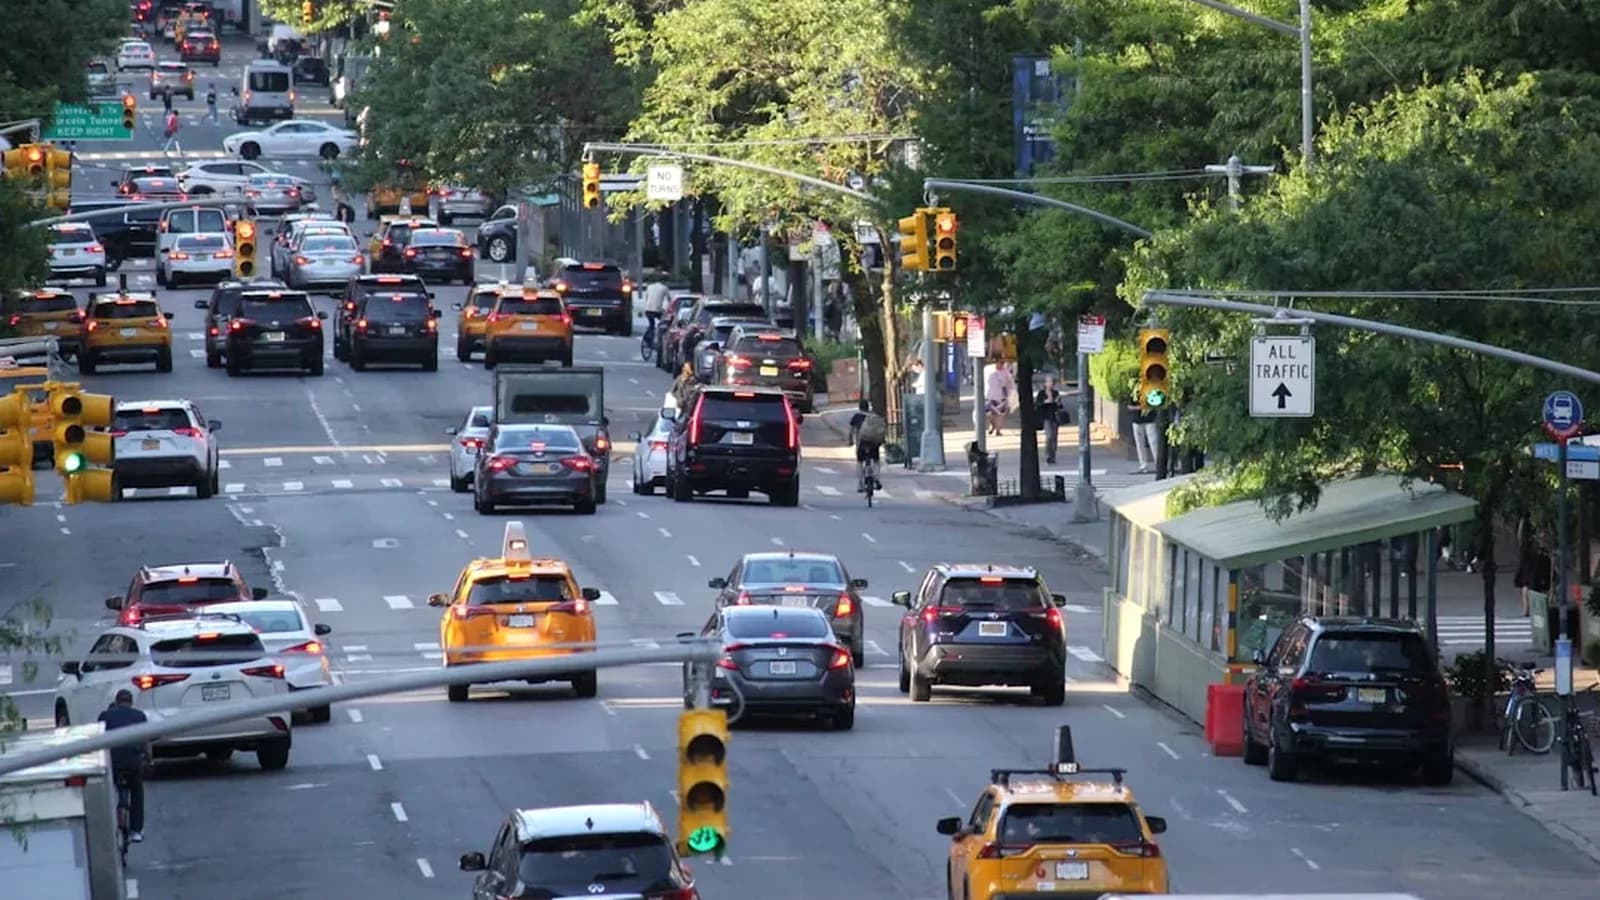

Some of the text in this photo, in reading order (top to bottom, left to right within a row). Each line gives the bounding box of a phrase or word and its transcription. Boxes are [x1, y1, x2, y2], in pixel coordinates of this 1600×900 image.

[57, 127, 115, 137] KEEP RIGHT
[657, 171, 672, 181] NO
[651, 184, 680, 193] TURNS
[1268, 345, 1297, 360] ALL
[1256, 364, 1309, 379] TRAFFIC
